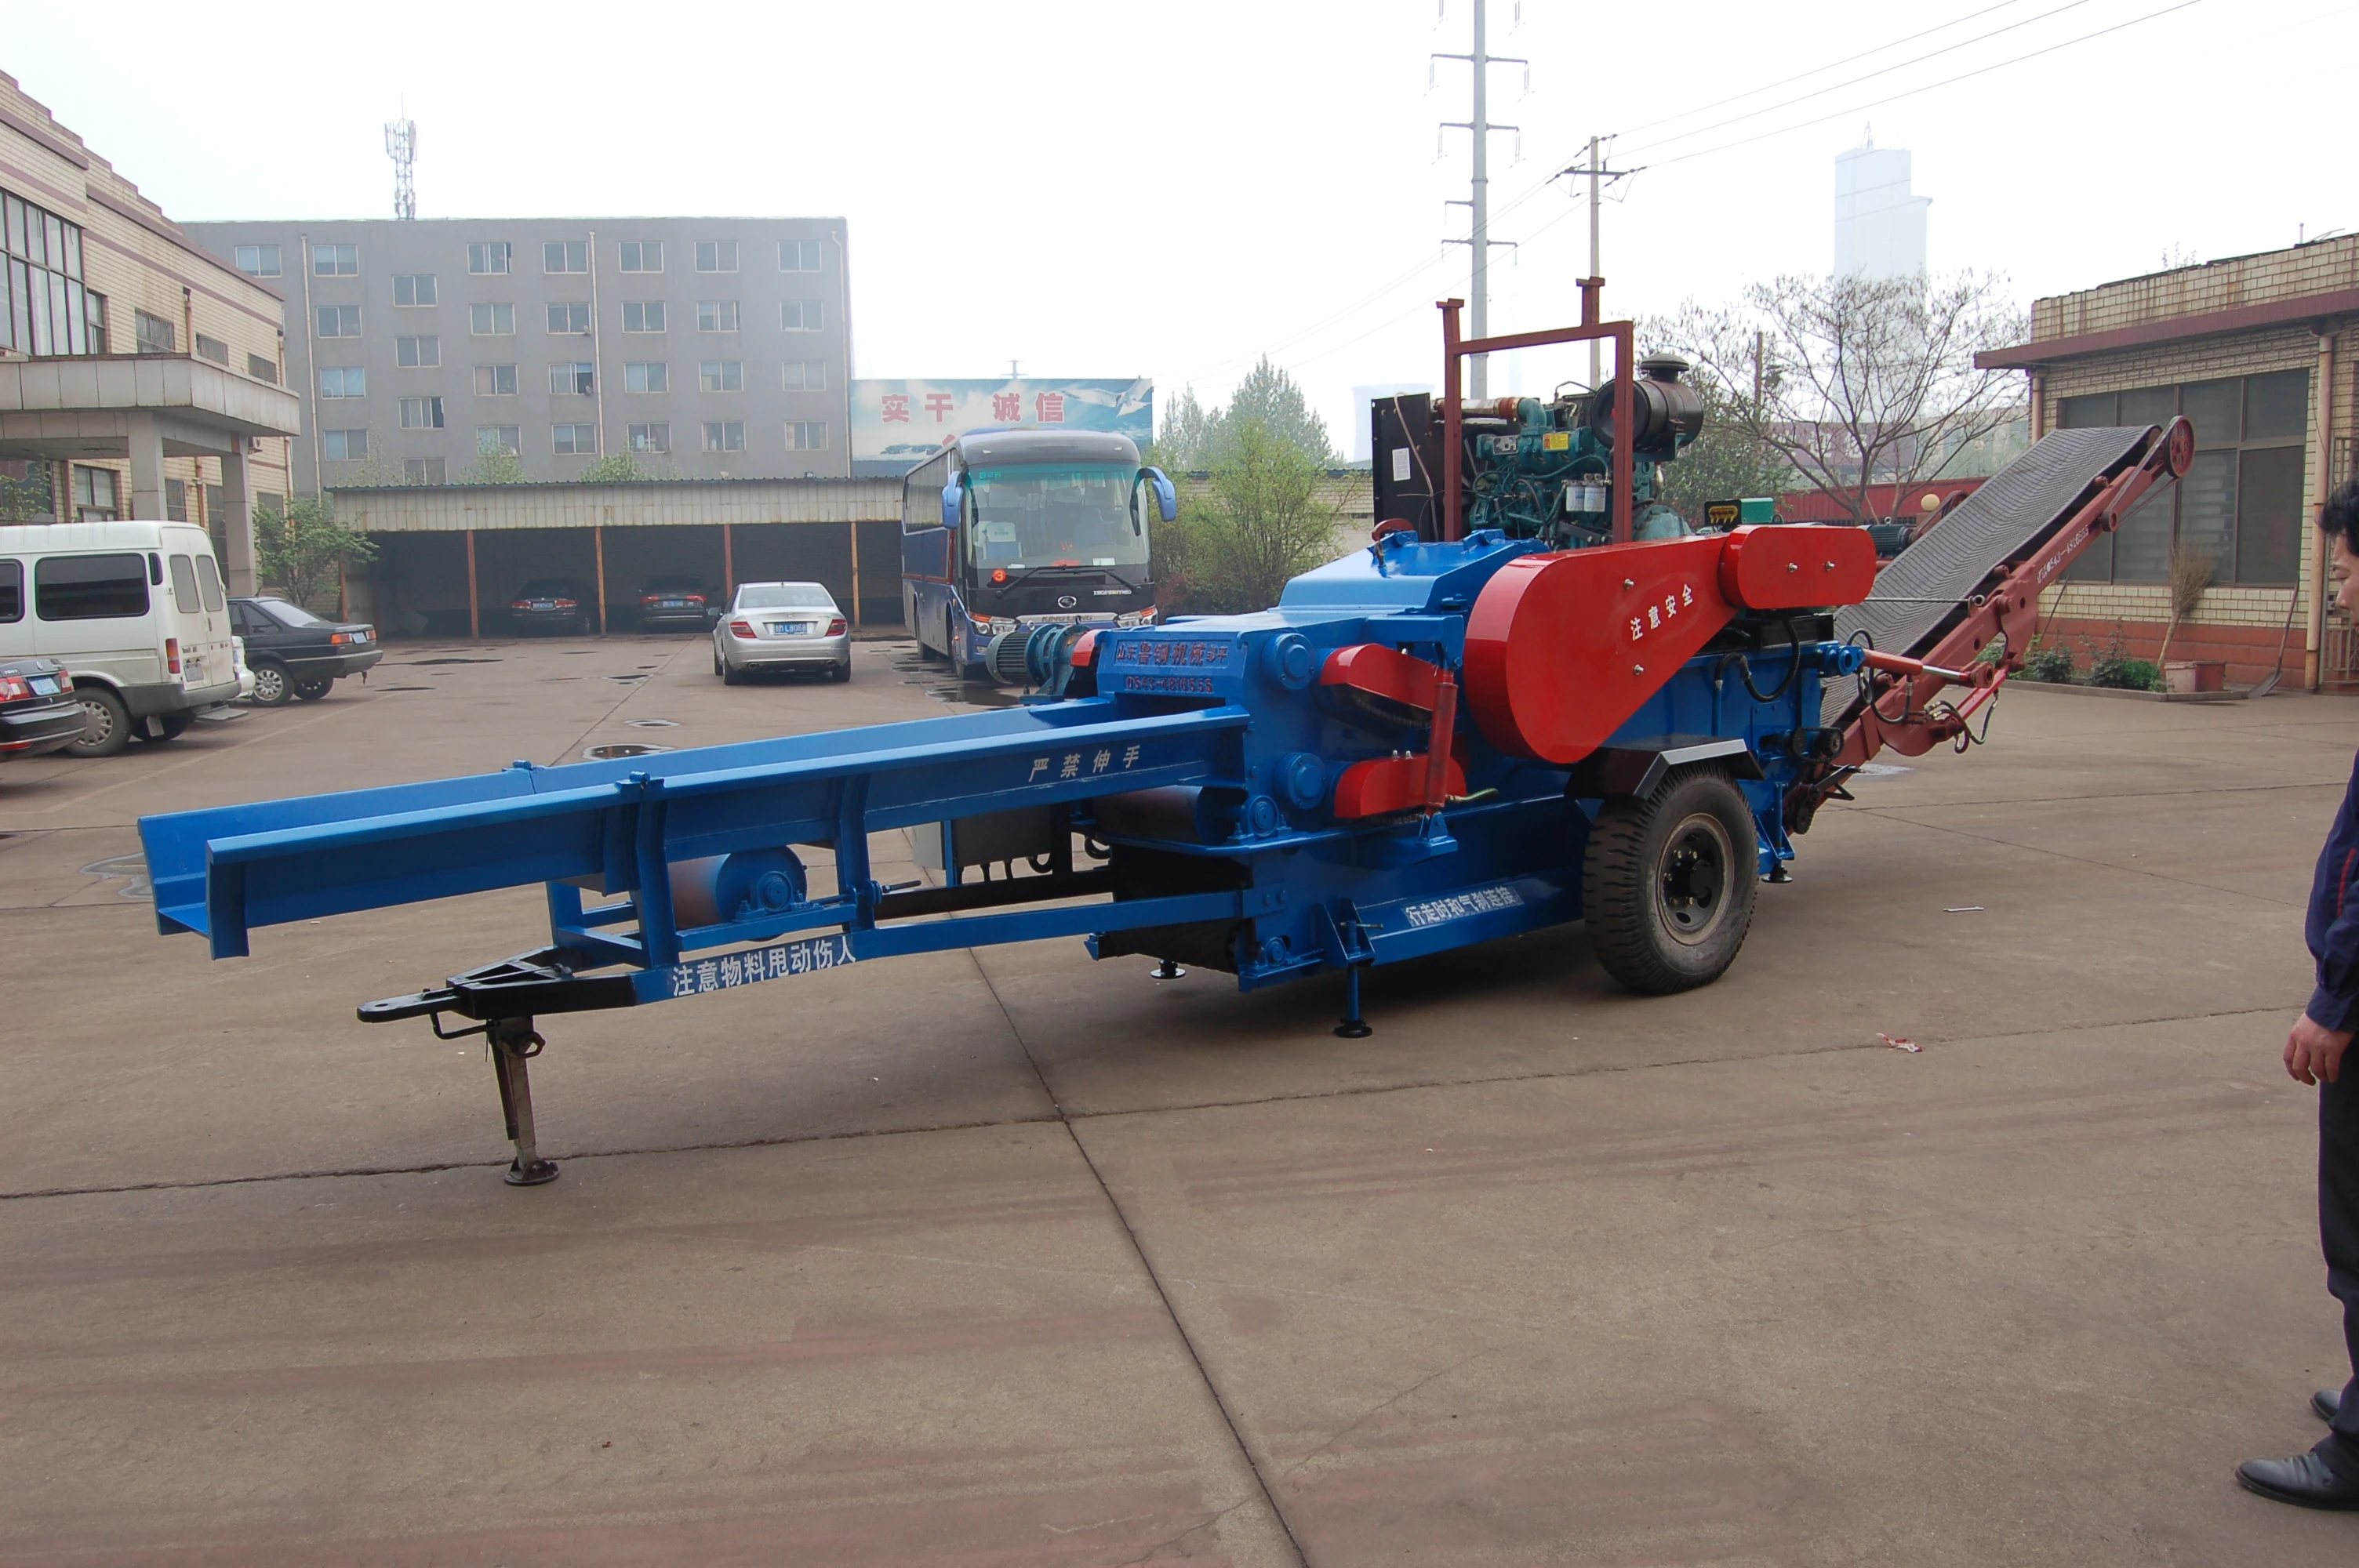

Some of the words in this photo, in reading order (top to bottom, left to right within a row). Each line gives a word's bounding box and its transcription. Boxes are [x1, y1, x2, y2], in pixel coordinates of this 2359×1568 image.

[881, 393, 954, 423] 实干
[992, 392, 1065, 423] 诚信
[1630, 583, 1693, 641] 注意安全
[1028, 745, 1142, 782] 严禁伸手
[1405, 885, 1518, 927] 行走时和气刹连接
[672, 935, 857, 997] 注意物料甩动伤人
